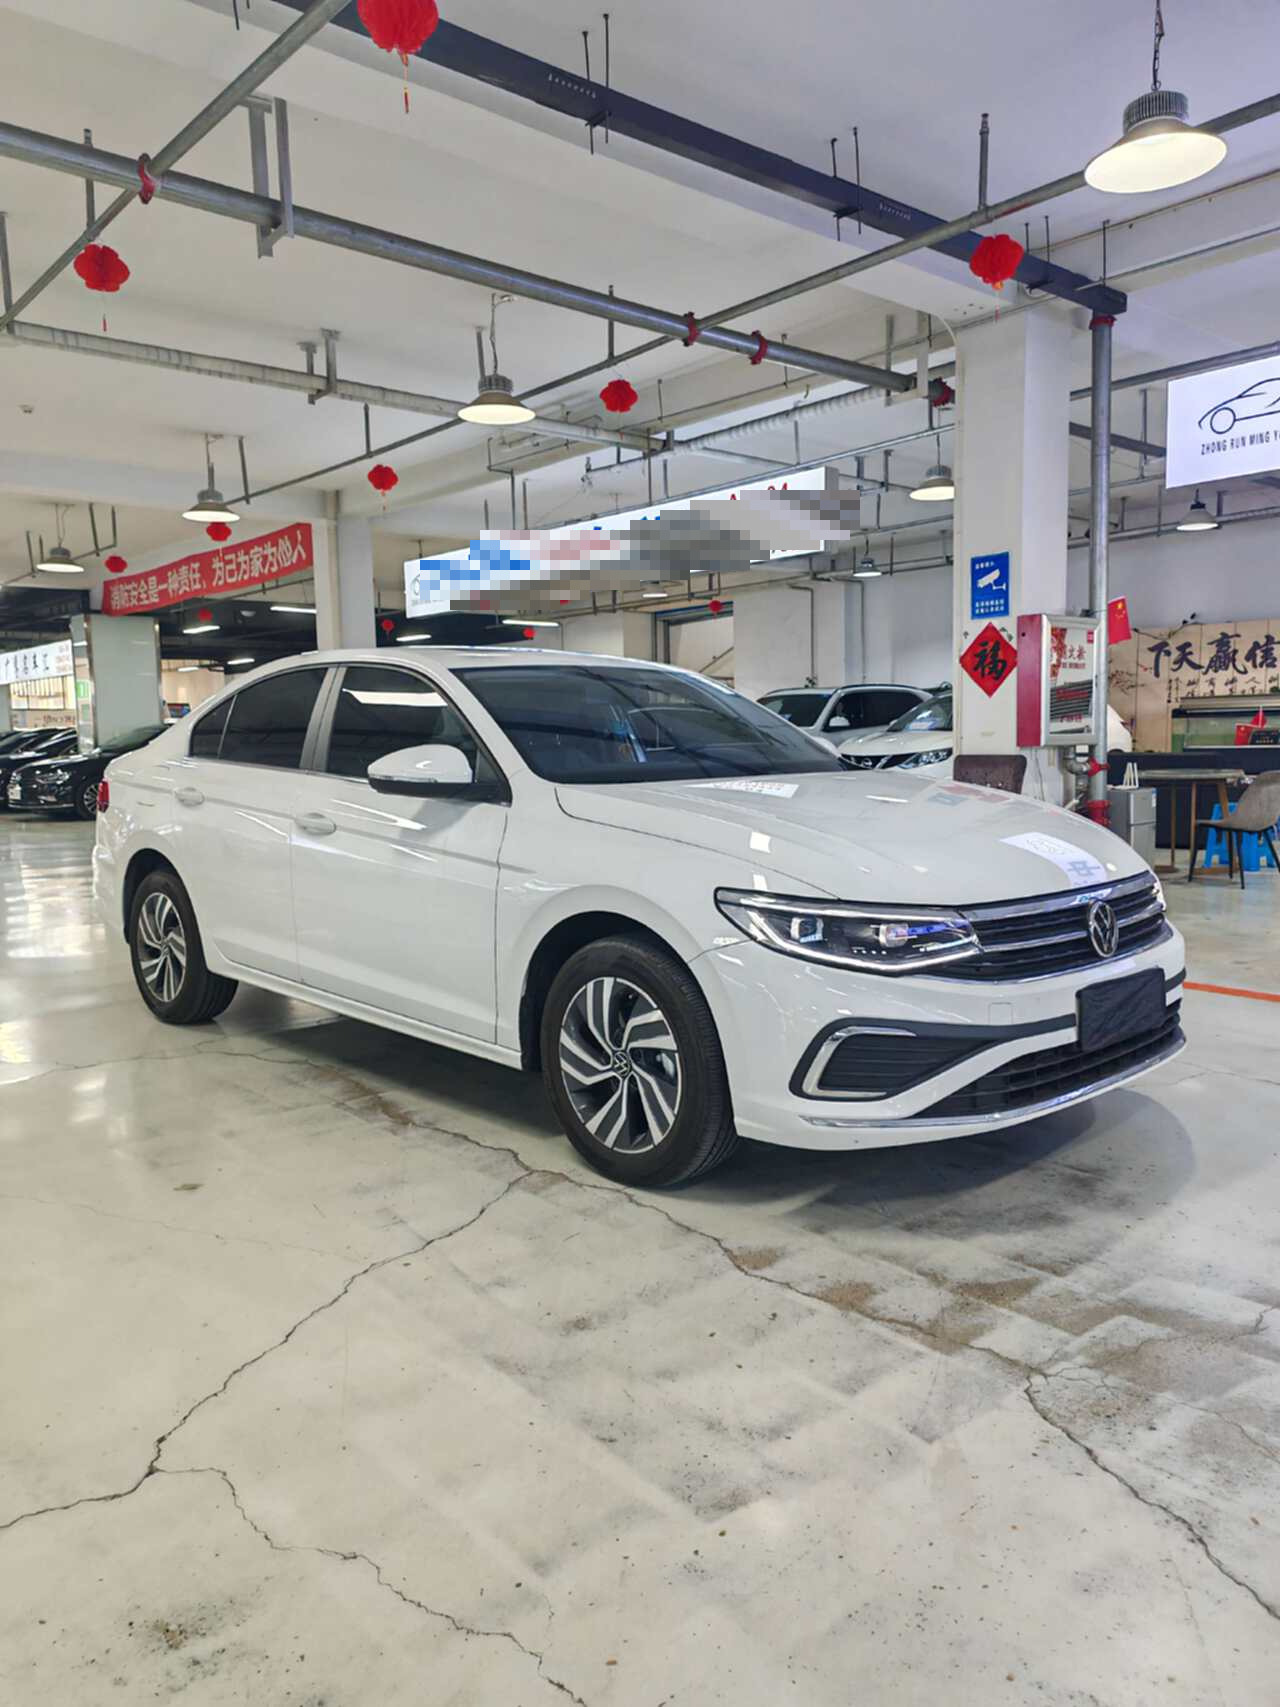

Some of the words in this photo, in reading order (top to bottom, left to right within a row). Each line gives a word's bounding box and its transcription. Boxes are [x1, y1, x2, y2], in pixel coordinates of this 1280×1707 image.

[1201, 440, 1227, 456] ZHONG
[1230, 437, 1246, 450] RUN
[1249, 430, 1270, 446] MING
[973, 640, 1007, 681] 福
